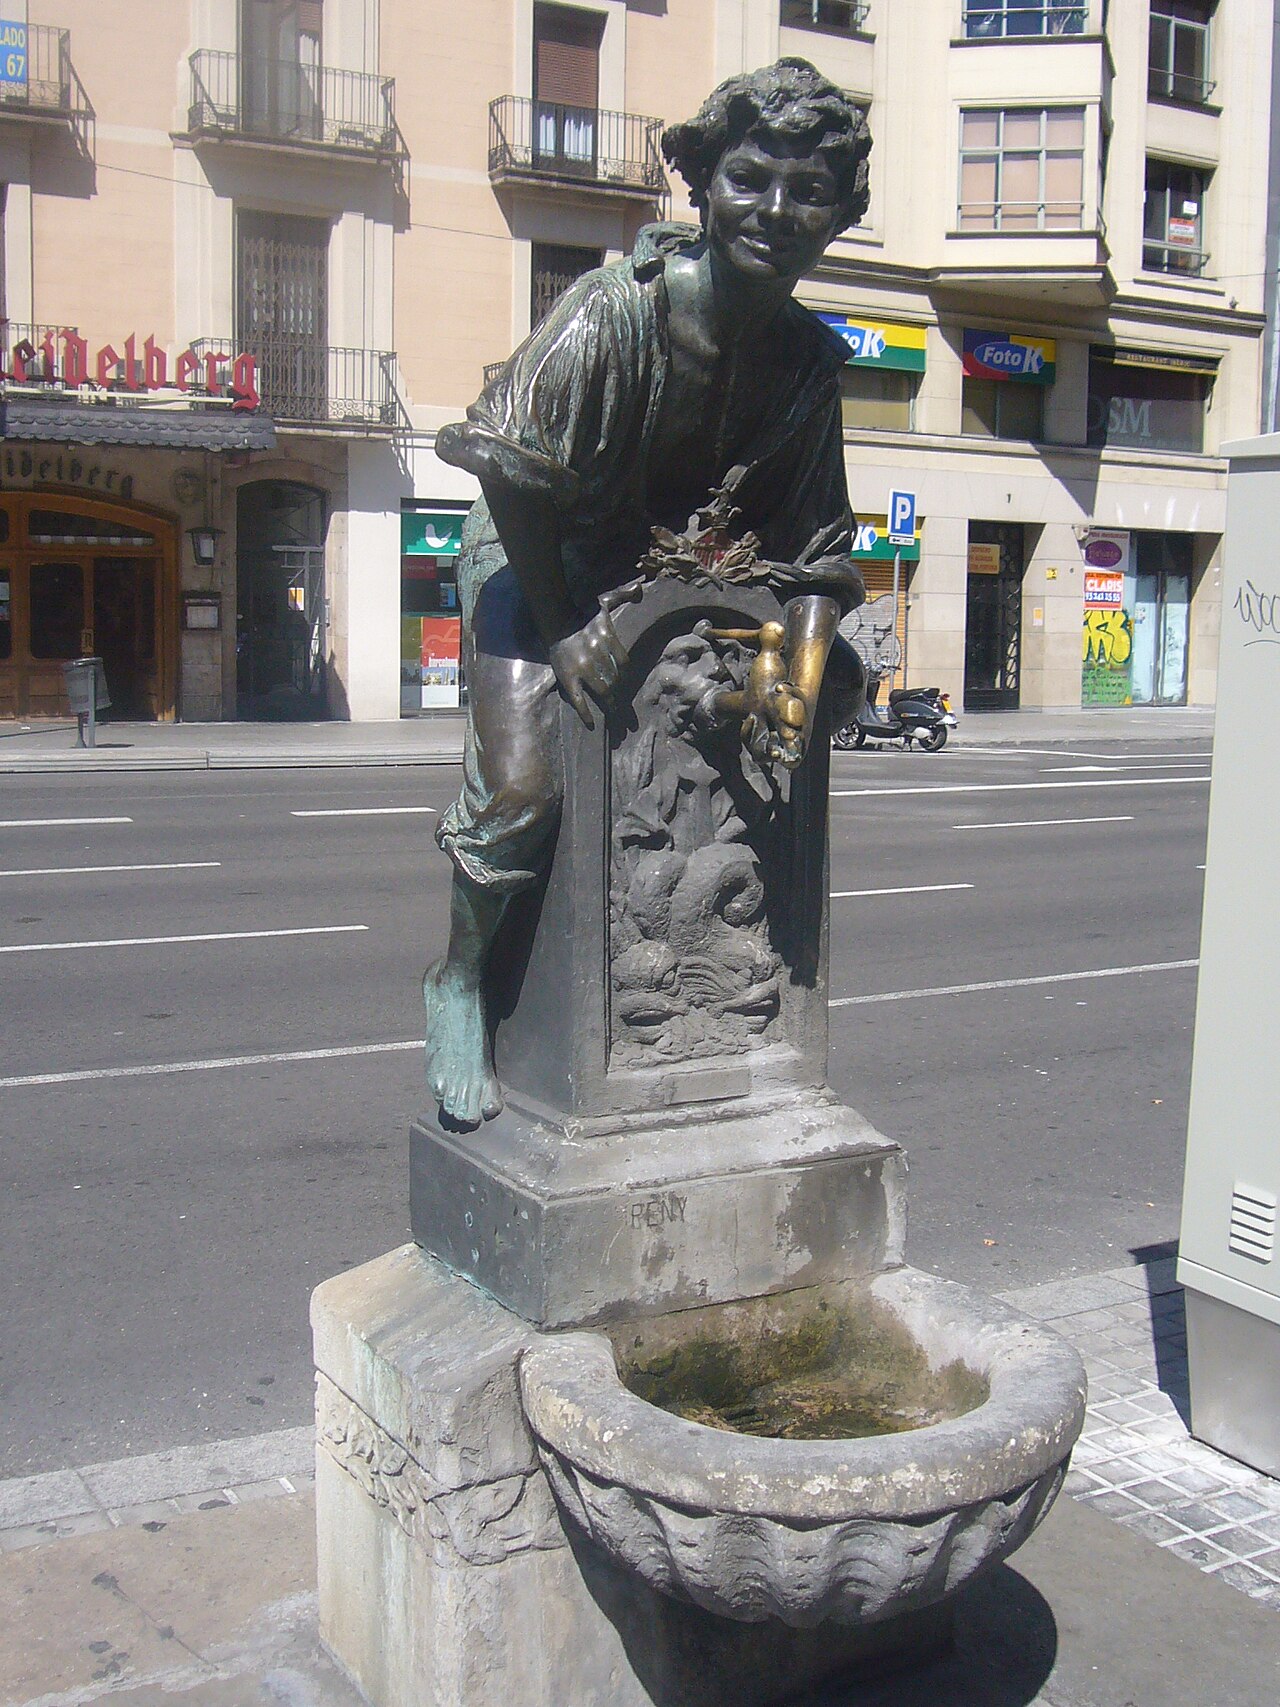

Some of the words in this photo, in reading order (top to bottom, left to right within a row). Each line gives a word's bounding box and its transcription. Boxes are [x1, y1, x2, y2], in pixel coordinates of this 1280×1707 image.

[6, 54, 25, 77] 67
[0, 327, 261, 411] eidelberg
[894, 496, 912, 530] P
[1086, 579, 1122, 592] CLARIS
